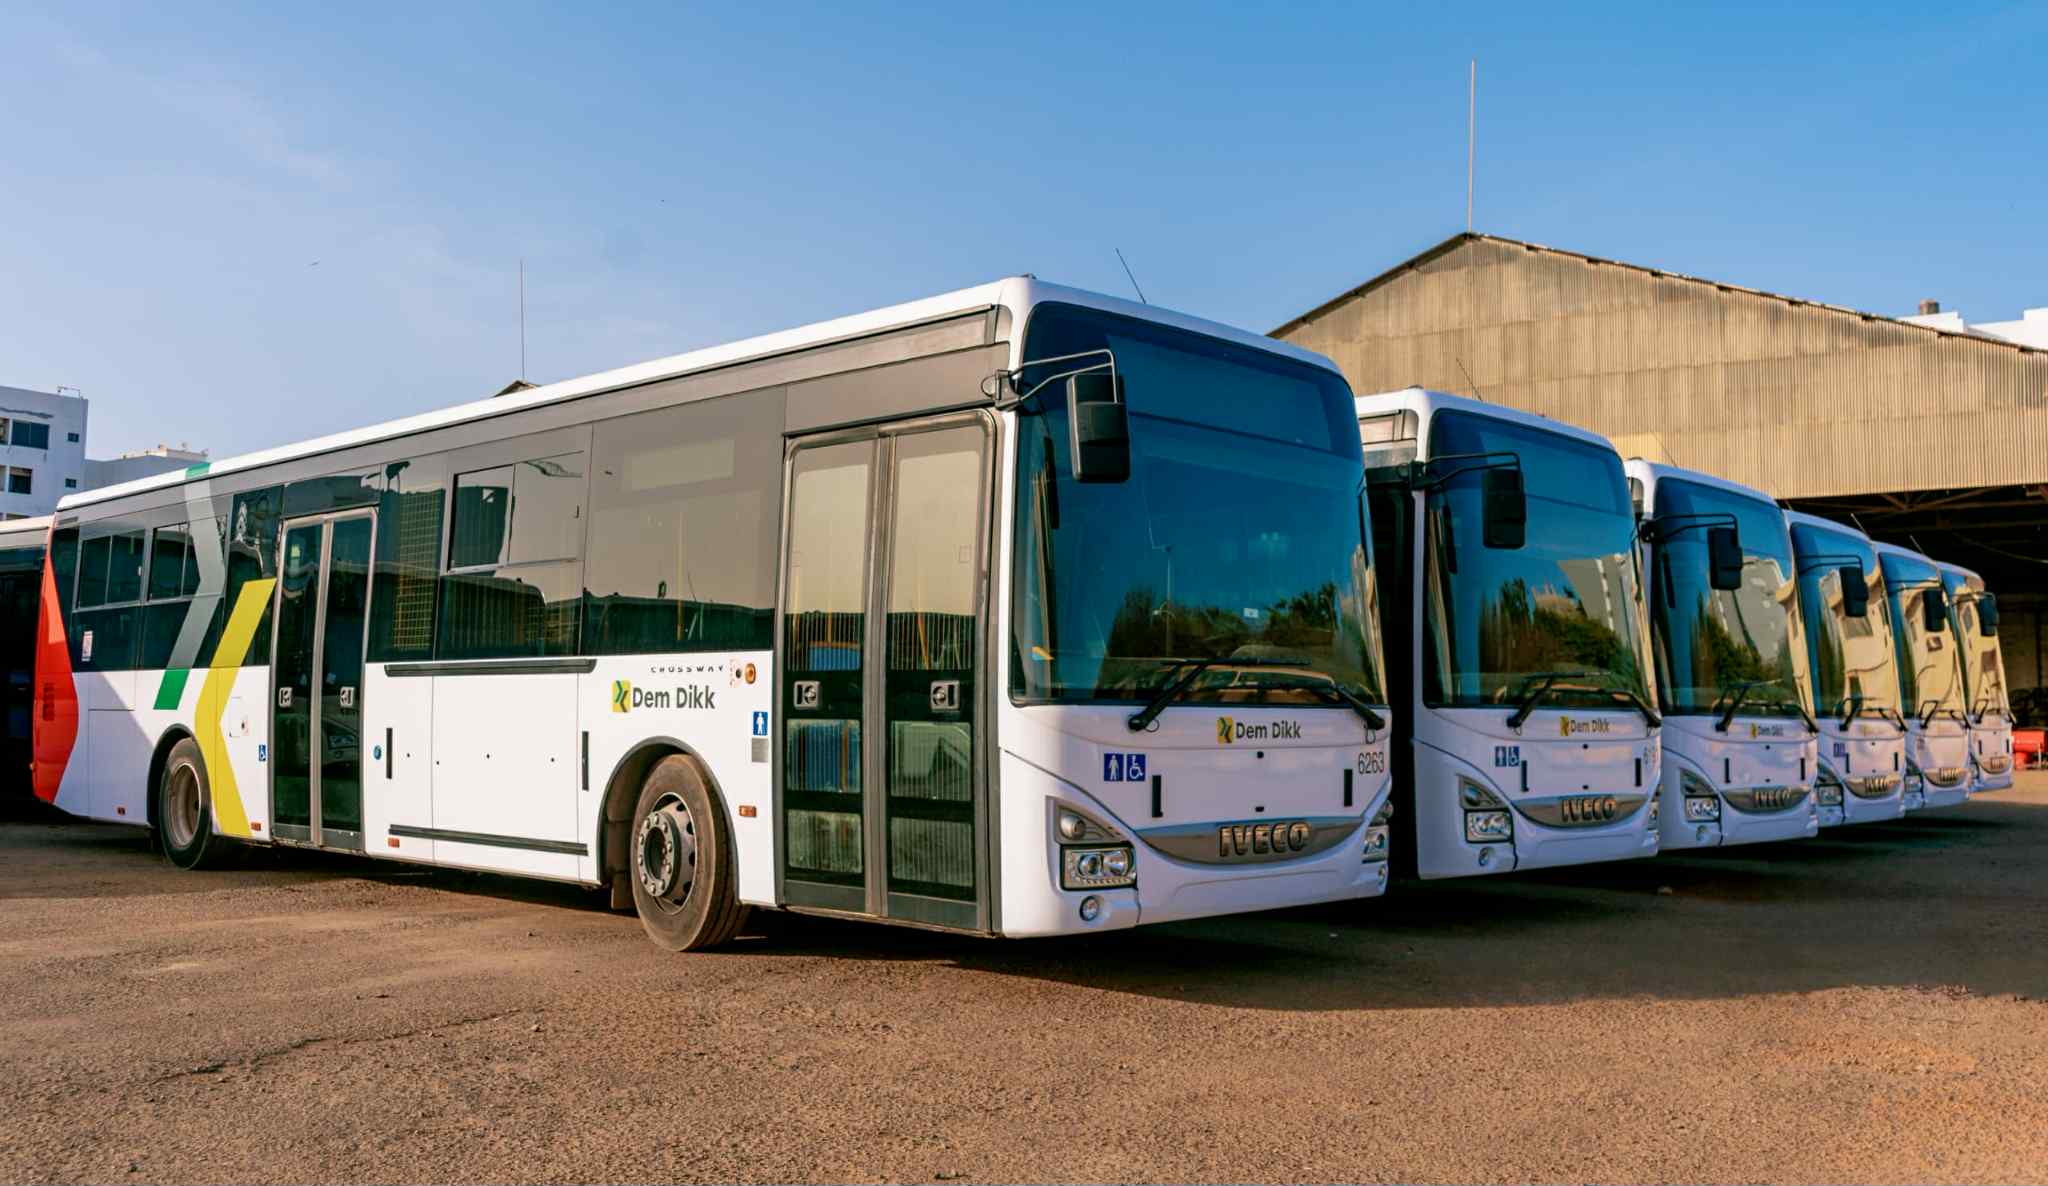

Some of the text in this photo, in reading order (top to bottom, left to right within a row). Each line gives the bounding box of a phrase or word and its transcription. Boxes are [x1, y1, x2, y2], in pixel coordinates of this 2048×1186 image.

[632, 684, 716, 710] Dem Dikk
[1235, 721, 1301, 739] Dem Dikk
[1570, 718, 1610, 733] Dem Dikk
[1358, 752, 1385, 775] 6263
[1562, 797, 1617, 822] IVECO
[1219, 822, 1310, 857] IVECO
